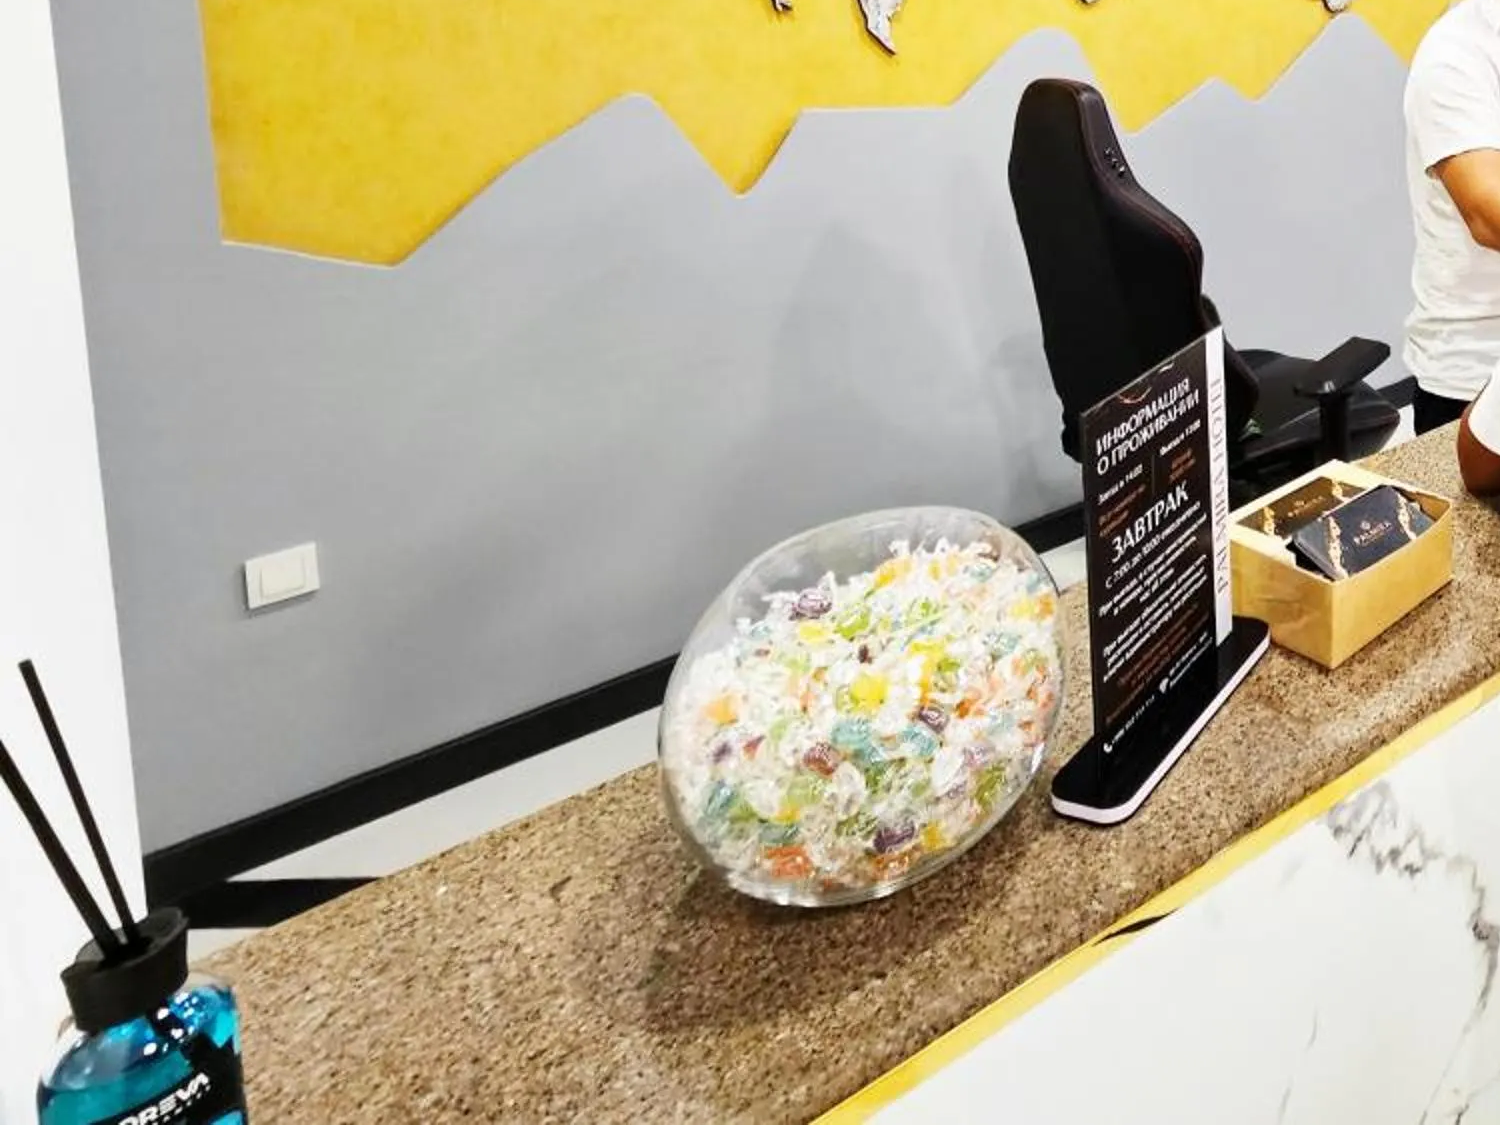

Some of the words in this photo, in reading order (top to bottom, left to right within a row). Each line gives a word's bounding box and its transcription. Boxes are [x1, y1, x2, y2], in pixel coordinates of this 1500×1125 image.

[1096, 377, 1190, 455] ИНФОРМАЦИЯ
[1097, 456, 1109, 475] О
[1112, 389, 1199, 466] ПРОЖИВАНИИ
[1111, 480, 1188, 563] ЗАВТРАК
